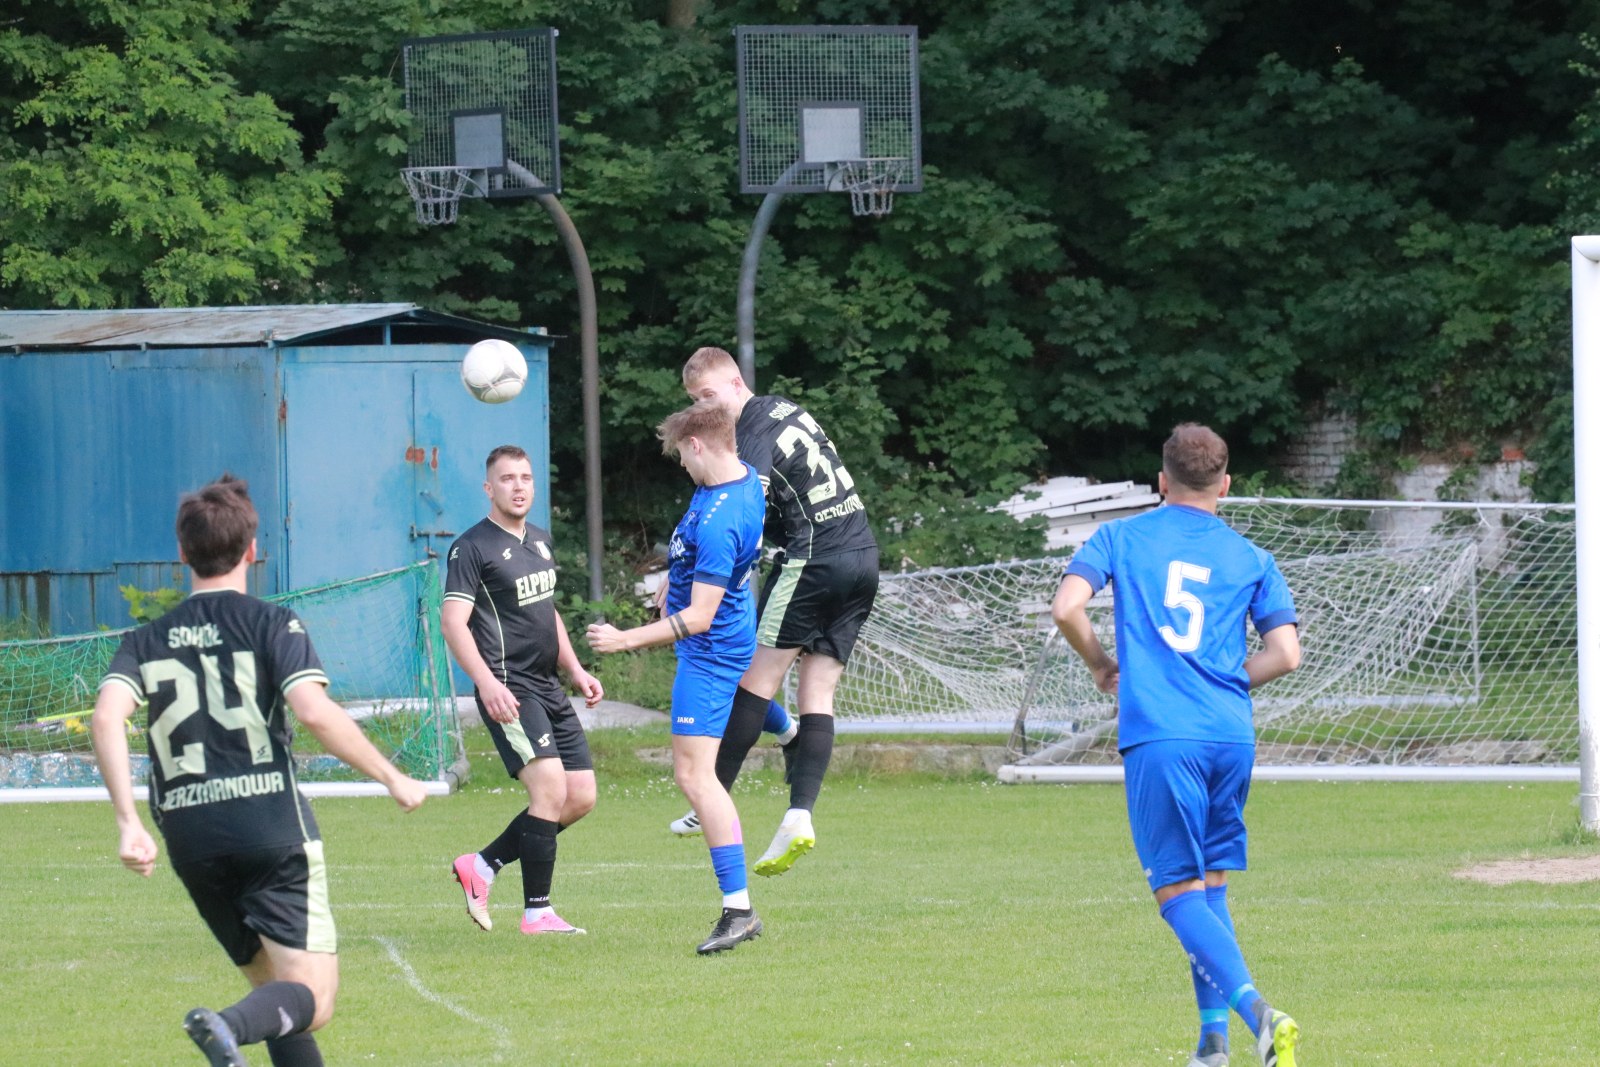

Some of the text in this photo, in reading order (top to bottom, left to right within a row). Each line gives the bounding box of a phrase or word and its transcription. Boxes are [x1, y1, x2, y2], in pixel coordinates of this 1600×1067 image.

[515, 568, 557, 600] ELPRO
[1158, 560, 1211, 652] 5
[139, 650, 274, 781] 24
[676, 716, 695, 724] JAKO
[159, 771, 285, 812] JERZMANOWA
